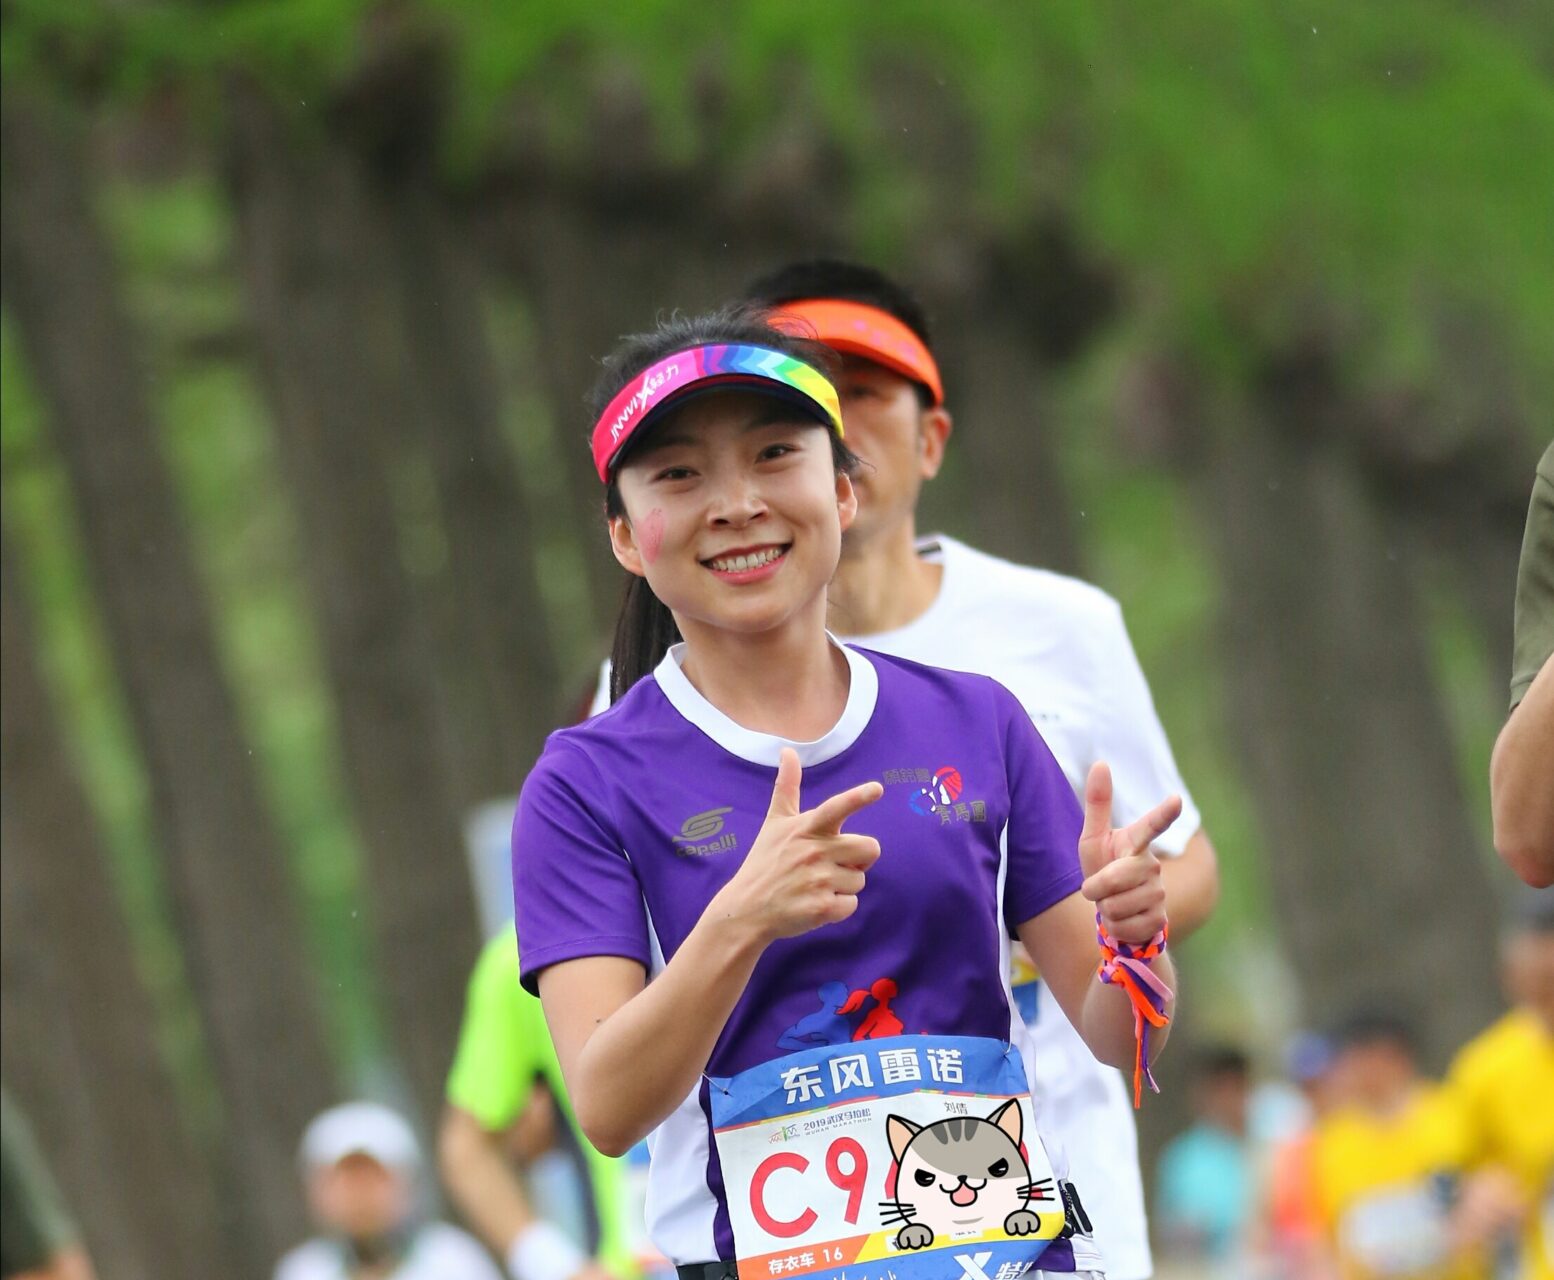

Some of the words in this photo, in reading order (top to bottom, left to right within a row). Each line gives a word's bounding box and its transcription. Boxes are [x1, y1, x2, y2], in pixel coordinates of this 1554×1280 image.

[780, 1048, 963, 1105] 东风雷诺
[803, 1107, 871, 1131] 2019武汉马拉松
[768, 1252, 815, 1275] 存衣车
[823, 1247, 843, 1262] 16
